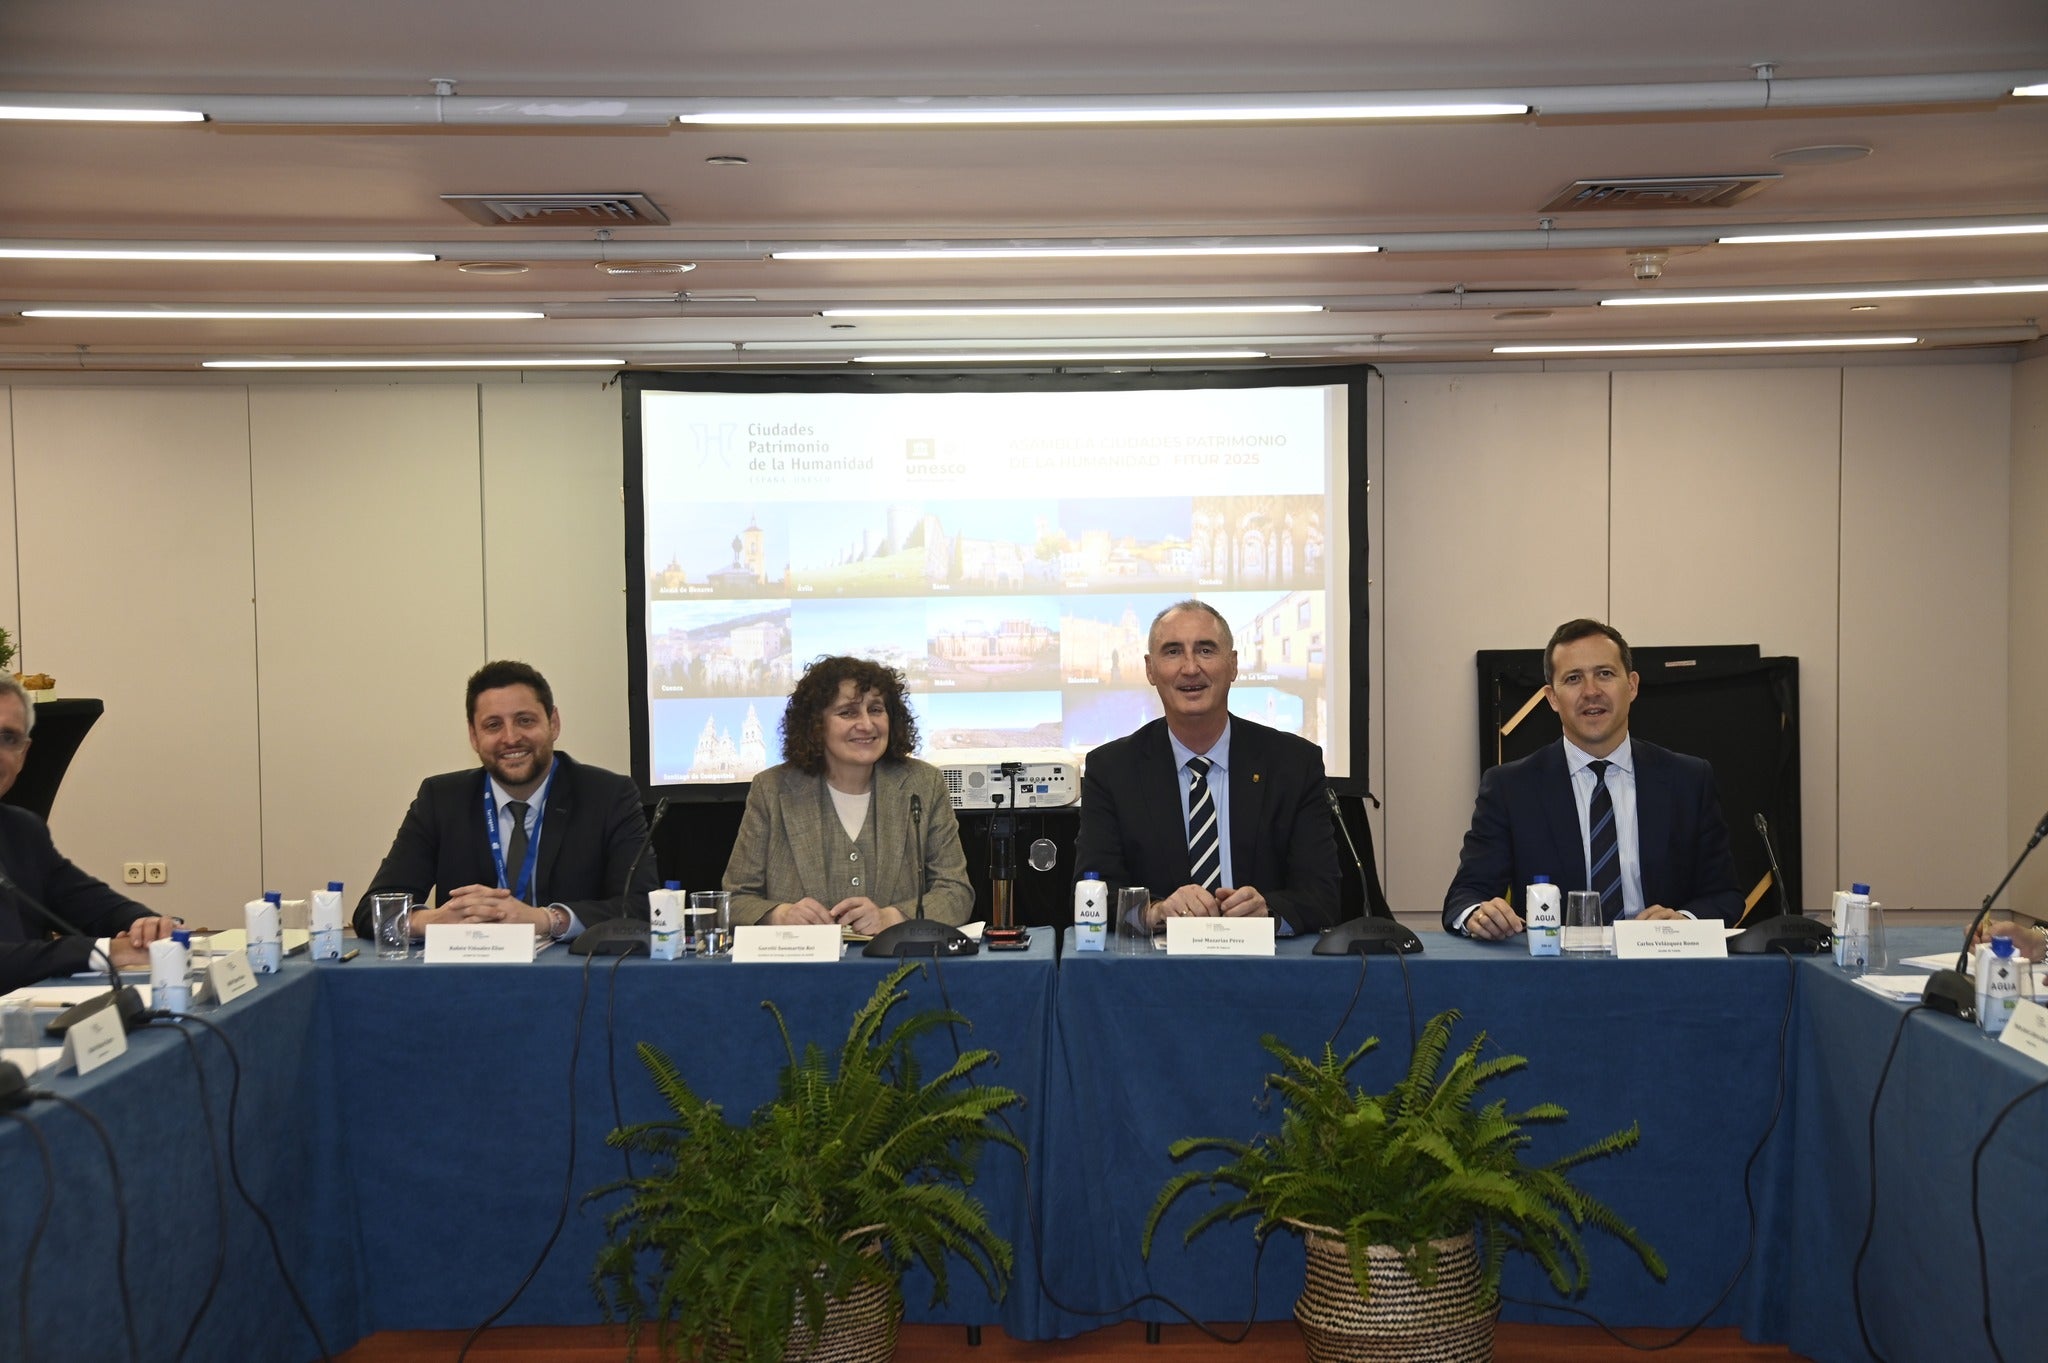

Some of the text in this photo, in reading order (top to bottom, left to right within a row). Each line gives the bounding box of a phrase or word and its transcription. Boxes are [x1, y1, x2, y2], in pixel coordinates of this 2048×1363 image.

[747, 422, 815, 437] Ciudades
[747, 439, 830, 454] Patrimonio
[1099, 435, 1182, 449] CIUDADES
[1186, 434, 1287, 448] PATRIMONIO
[748, 456, 874, 471] de la Humanidad
[1060, 454, 1161, 468] HUMANIDAD
[1173, 453, 1220, 466] FITUR
[1223, 453, 1261, 465] 2025
[905, 463, 967, 475] unesco
[661, 684, 684, 692] Cuenca
[1080, 910, 1100, 918] AGUA
[1534, 914, 1556, 922] AGUA
[1990, 981, 2017, 992] AGUA
